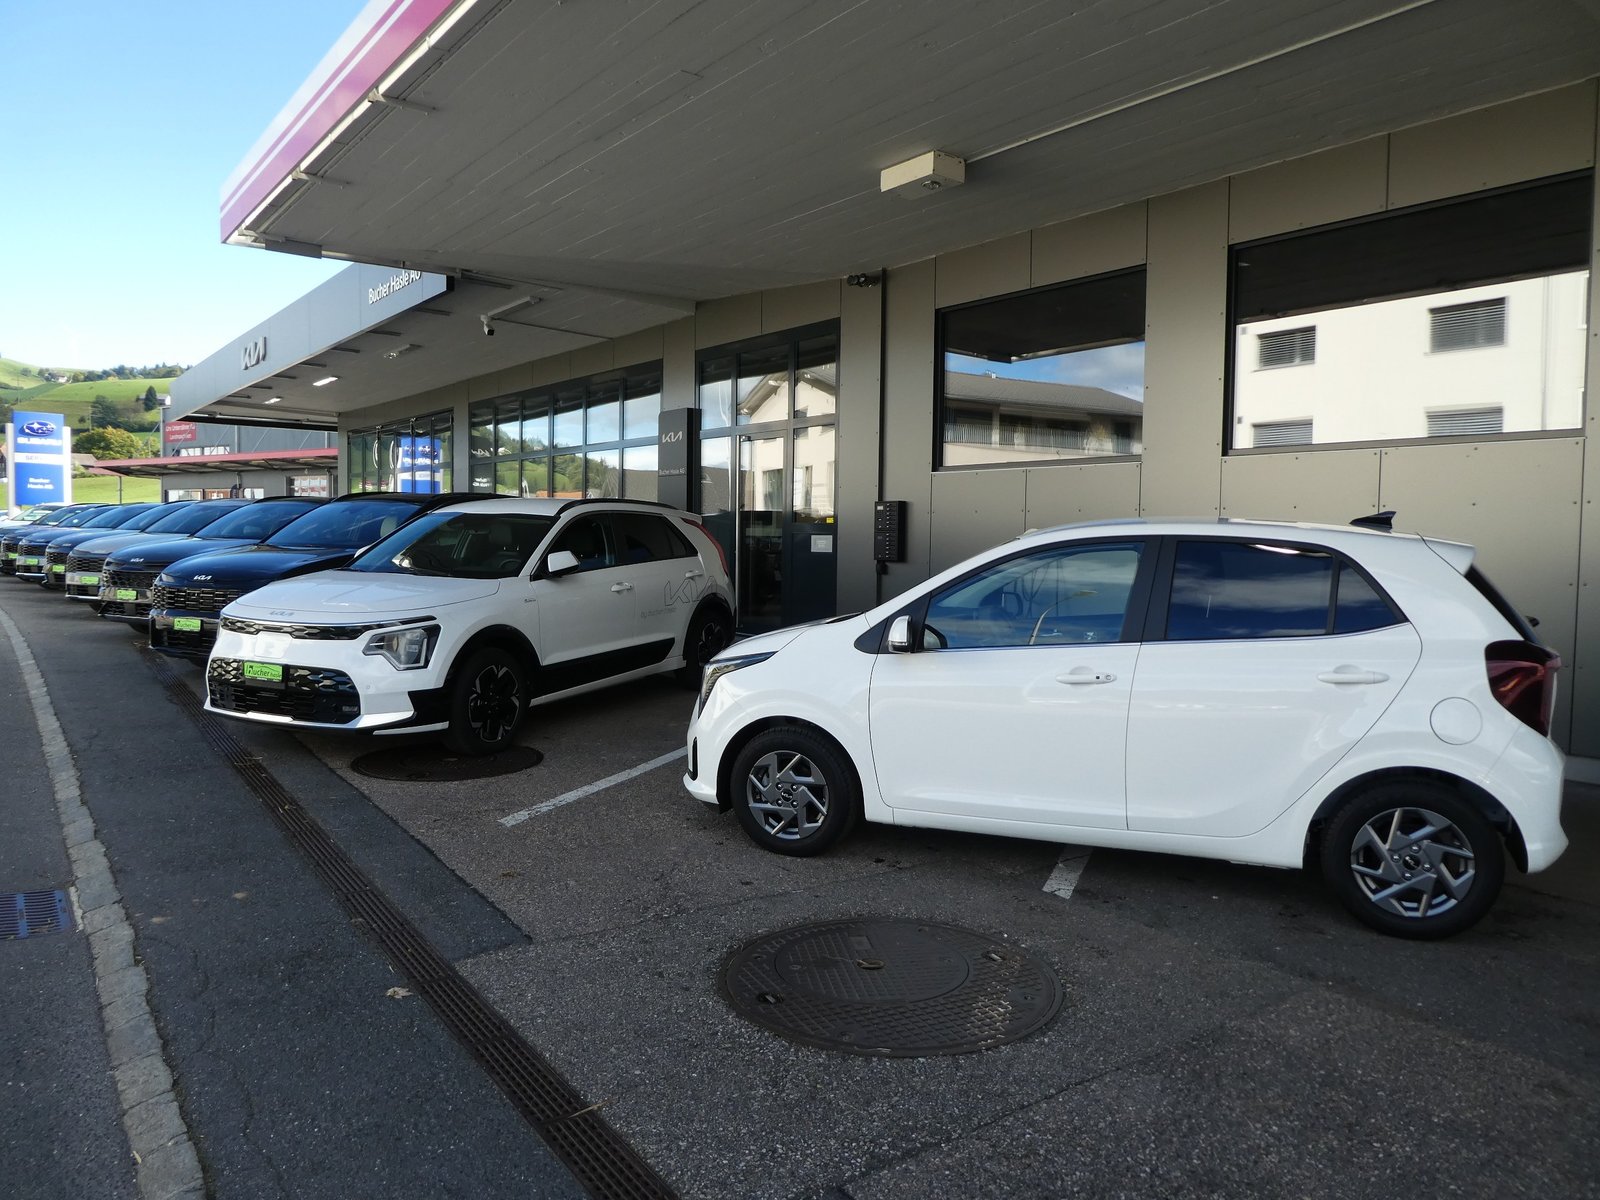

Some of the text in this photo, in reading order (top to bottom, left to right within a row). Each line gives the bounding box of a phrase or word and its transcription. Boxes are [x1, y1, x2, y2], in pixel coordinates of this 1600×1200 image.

[369, 283, 390, 304] Bucher
[390, 270, 410, 293] Hasle
[662, 431, 682, 443] KIA
